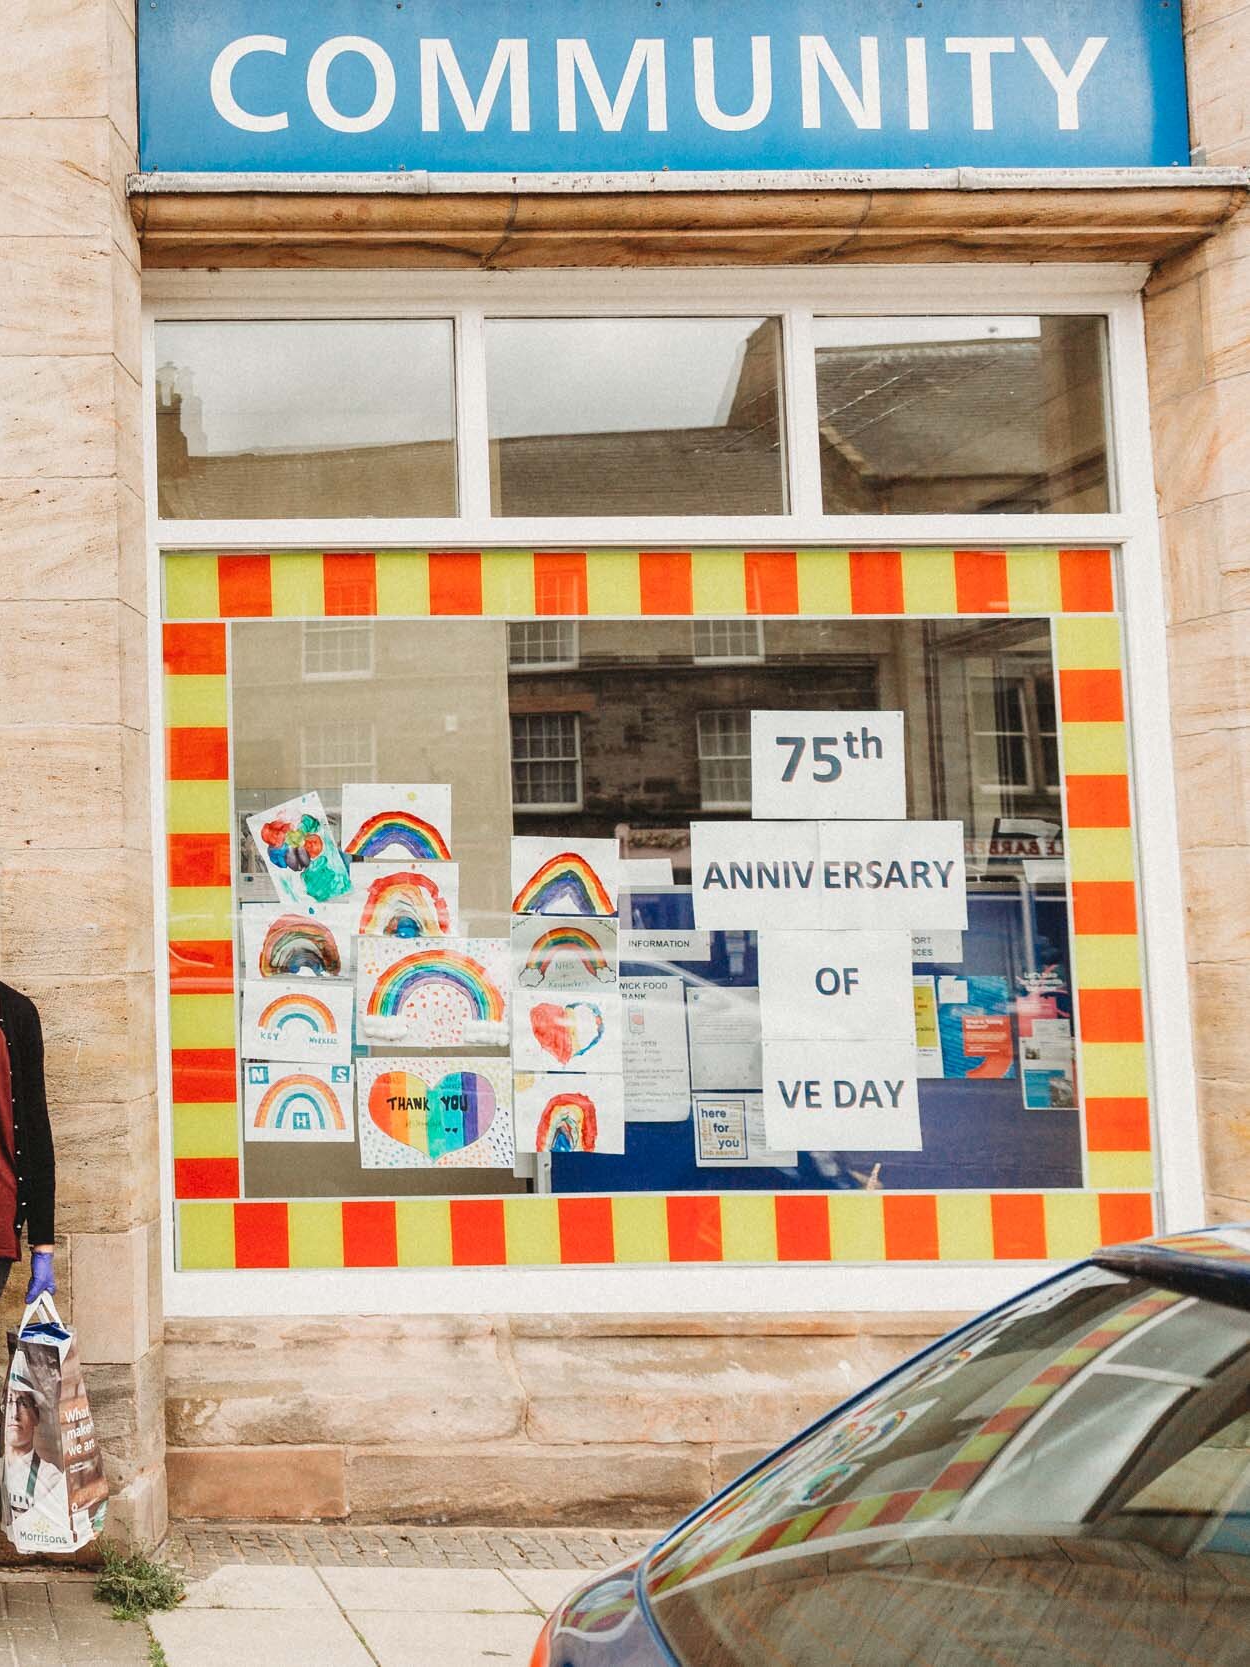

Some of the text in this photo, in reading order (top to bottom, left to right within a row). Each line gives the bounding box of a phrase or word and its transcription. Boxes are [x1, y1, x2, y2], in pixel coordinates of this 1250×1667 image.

[209, 33, 1108, 133] COMMUNITY
[775, 727, 883, 783] 75th
[702, 860, 955, 890] ANNIVERSARY
[628, 940, 690, 948] INFORMATION
[643, 982, 668, 990] FOOD
[815, 967, 859, 996] OF
[778, 1080, 904, 1109] VE DAY
[386, 1095, 468, 1112] THANK YOU
[701, 1109, 727, 1118] here
[713, 1123, 730, 1133] for
[718, 1139, 740, 1150] you
[68, 1443, 82, 1457] we
[20, 1532, 68, 1545] Morrisons
